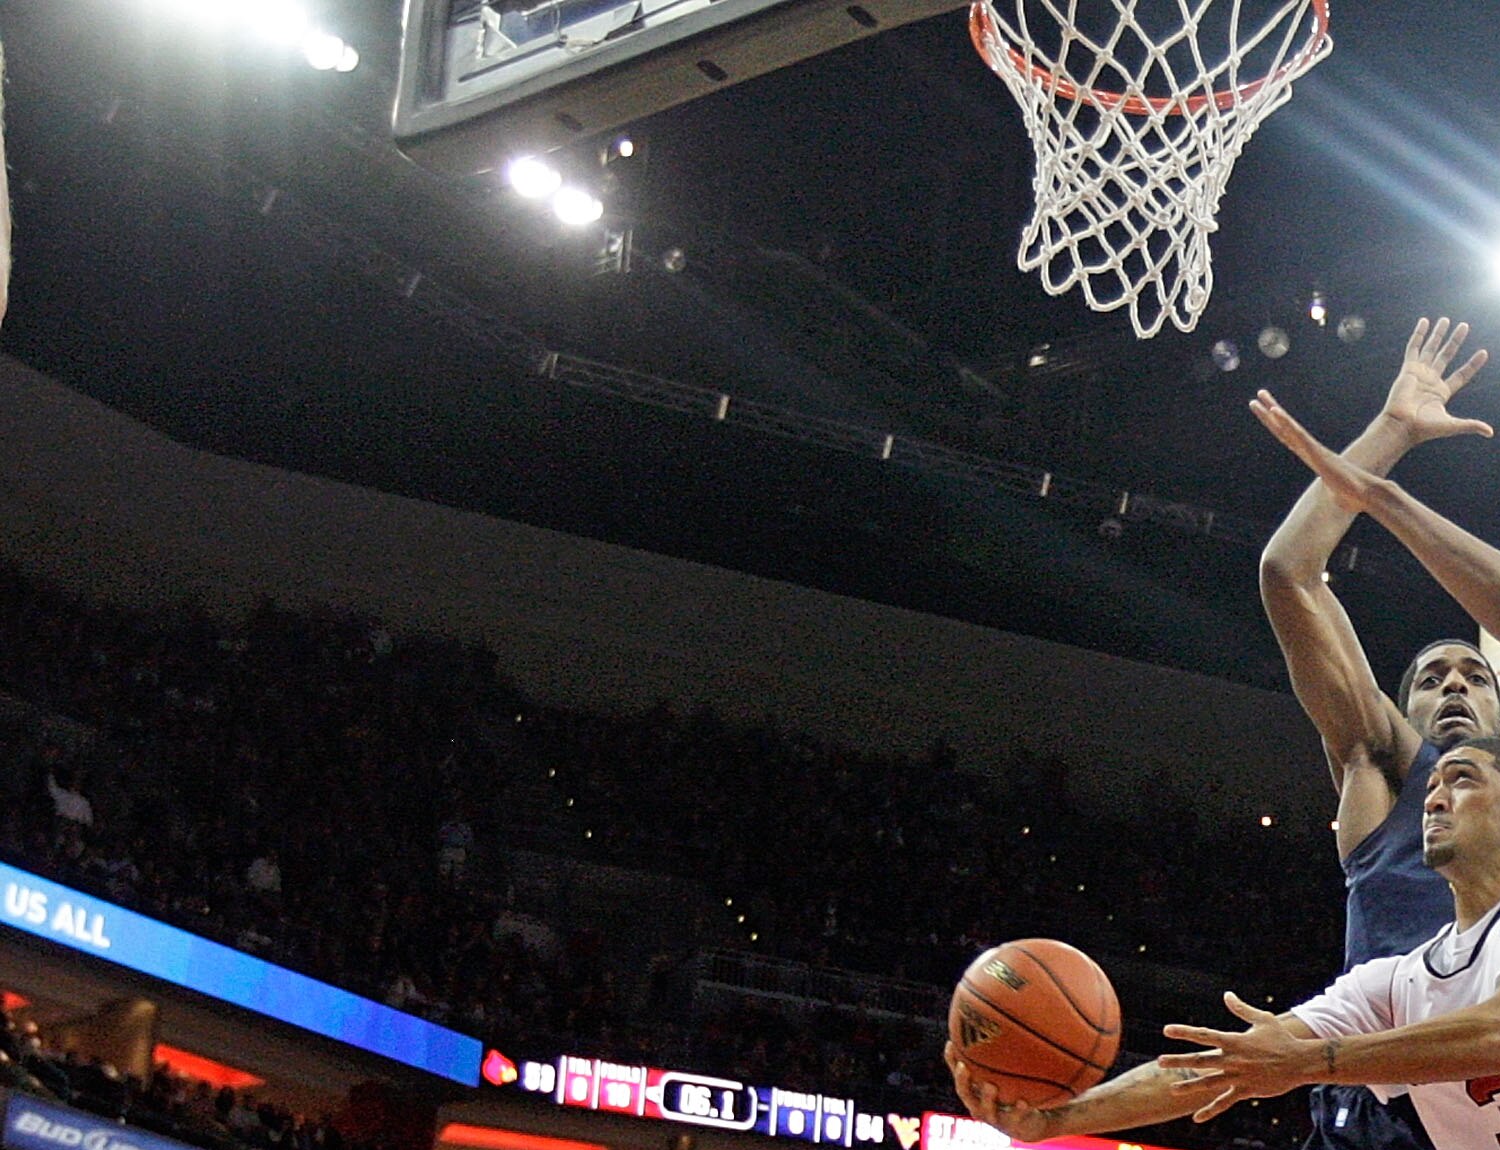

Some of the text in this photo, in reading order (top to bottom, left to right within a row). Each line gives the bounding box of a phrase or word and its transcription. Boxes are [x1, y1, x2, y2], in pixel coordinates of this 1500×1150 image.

[4, 883, 110, 950] US ALL
[13, 1109, 84, 1148] BUD
